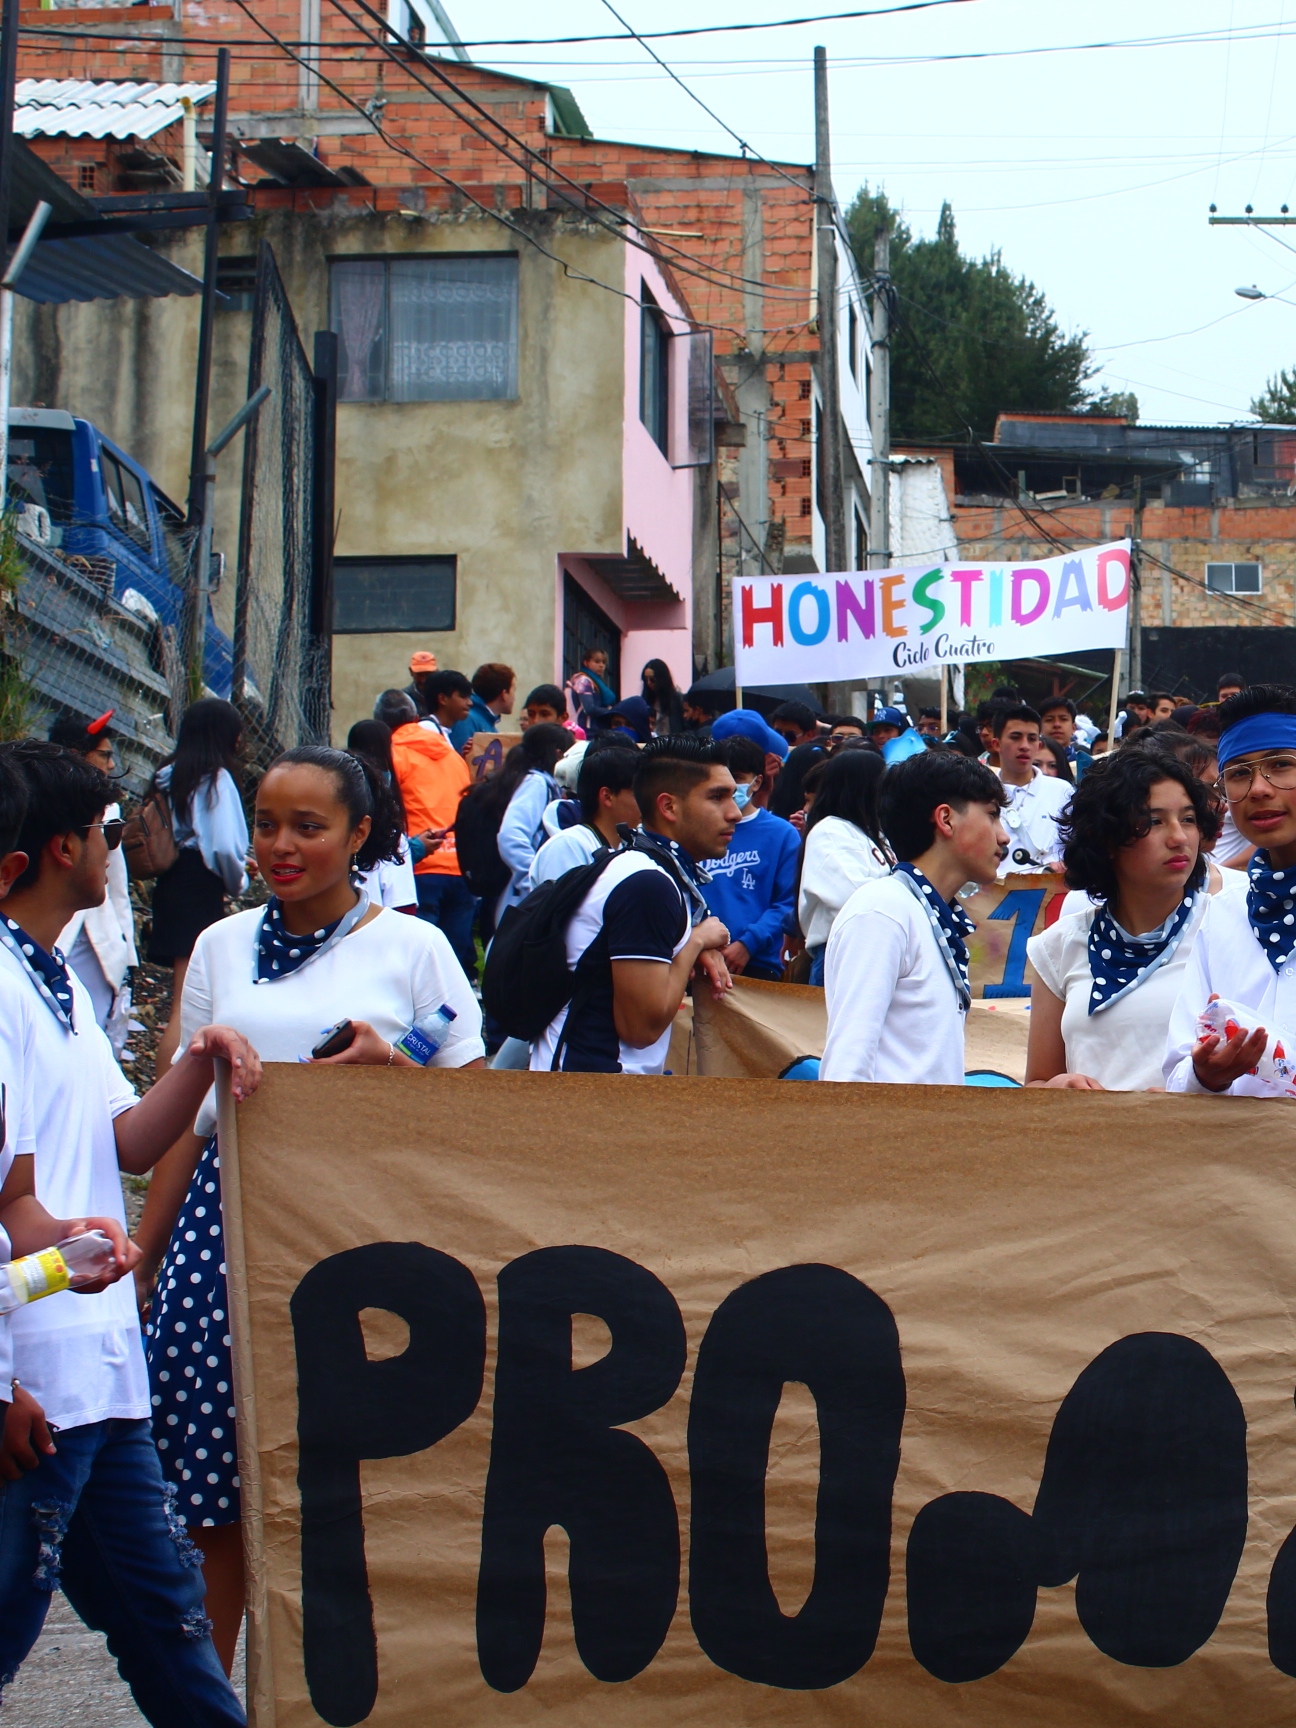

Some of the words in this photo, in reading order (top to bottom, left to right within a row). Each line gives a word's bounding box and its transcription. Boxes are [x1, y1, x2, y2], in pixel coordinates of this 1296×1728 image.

[741, 548, 1131, 649] HONESTIDAD
[892, 641, 930, 668] Ciclo
[934, 633, 996, 658] Cuatro
[407, 1033, 431, 1056] CRISTAL
